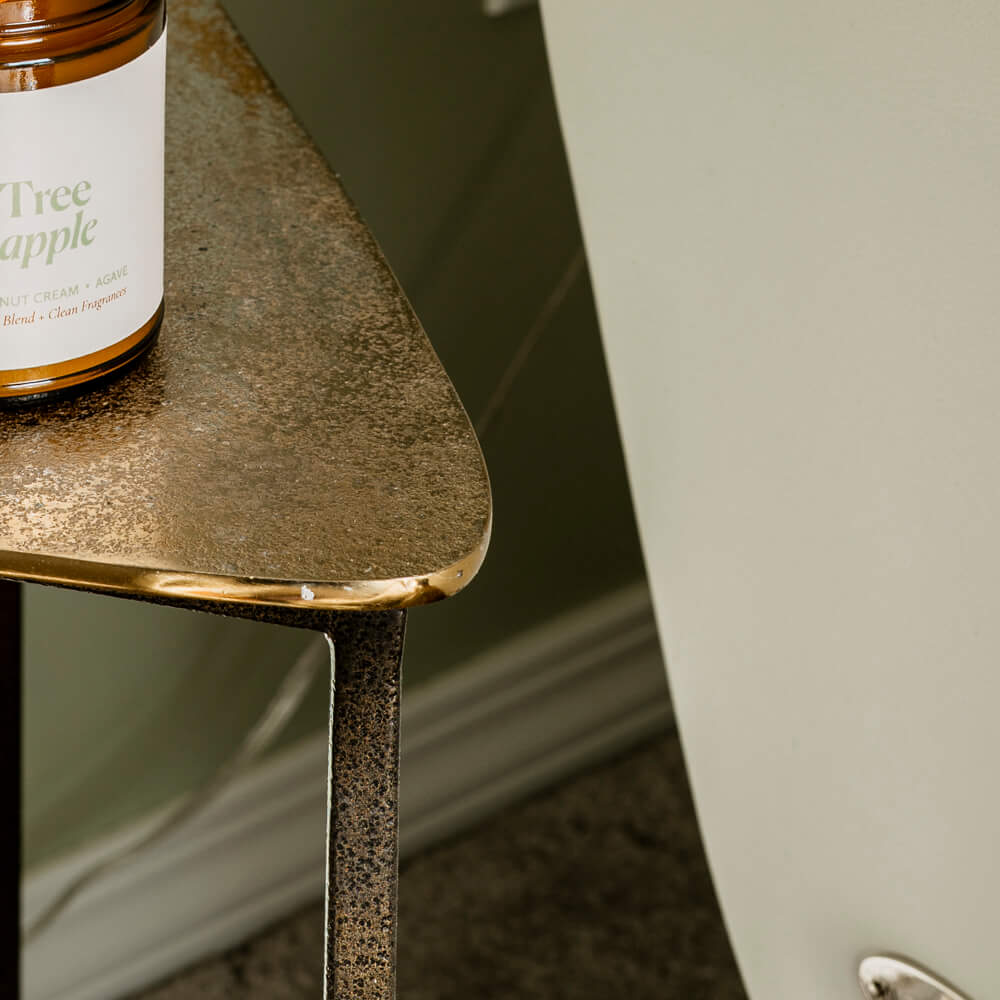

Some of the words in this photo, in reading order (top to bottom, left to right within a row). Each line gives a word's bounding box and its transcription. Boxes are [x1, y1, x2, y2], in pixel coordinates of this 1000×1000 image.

[33, 284, 80, 304] CREAM
[95, 264, 129, 288] AGAVE
[3, 311, 36, 327] Blend
[48, 303, 78, 320] Clean
[81, 287, 128, 312] Fragrances
